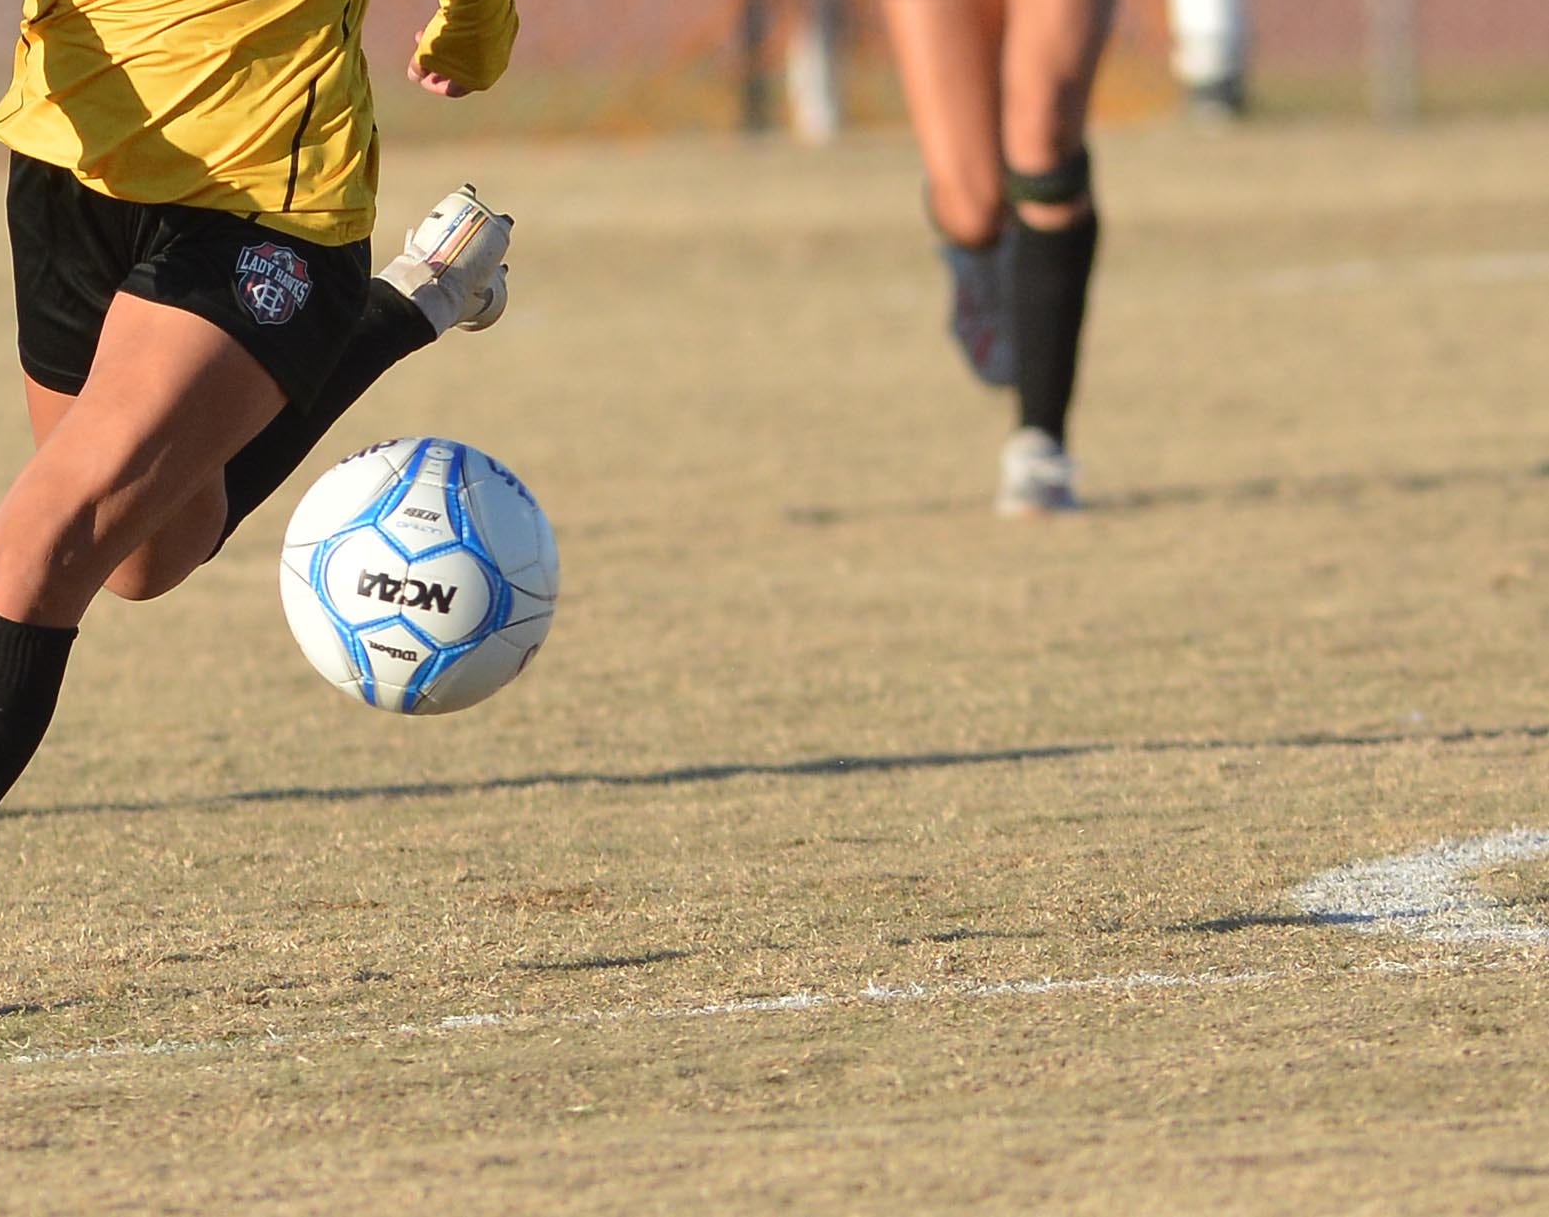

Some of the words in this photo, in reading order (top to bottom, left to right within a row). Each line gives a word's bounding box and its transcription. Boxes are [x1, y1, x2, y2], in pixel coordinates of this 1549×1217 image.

[239, 250, 275, 275] LADY
[275, 267, 309, 303] HAWKS
[356, 568, 458, 615] NCAA
[368, 639, 419, 663] Wilson
